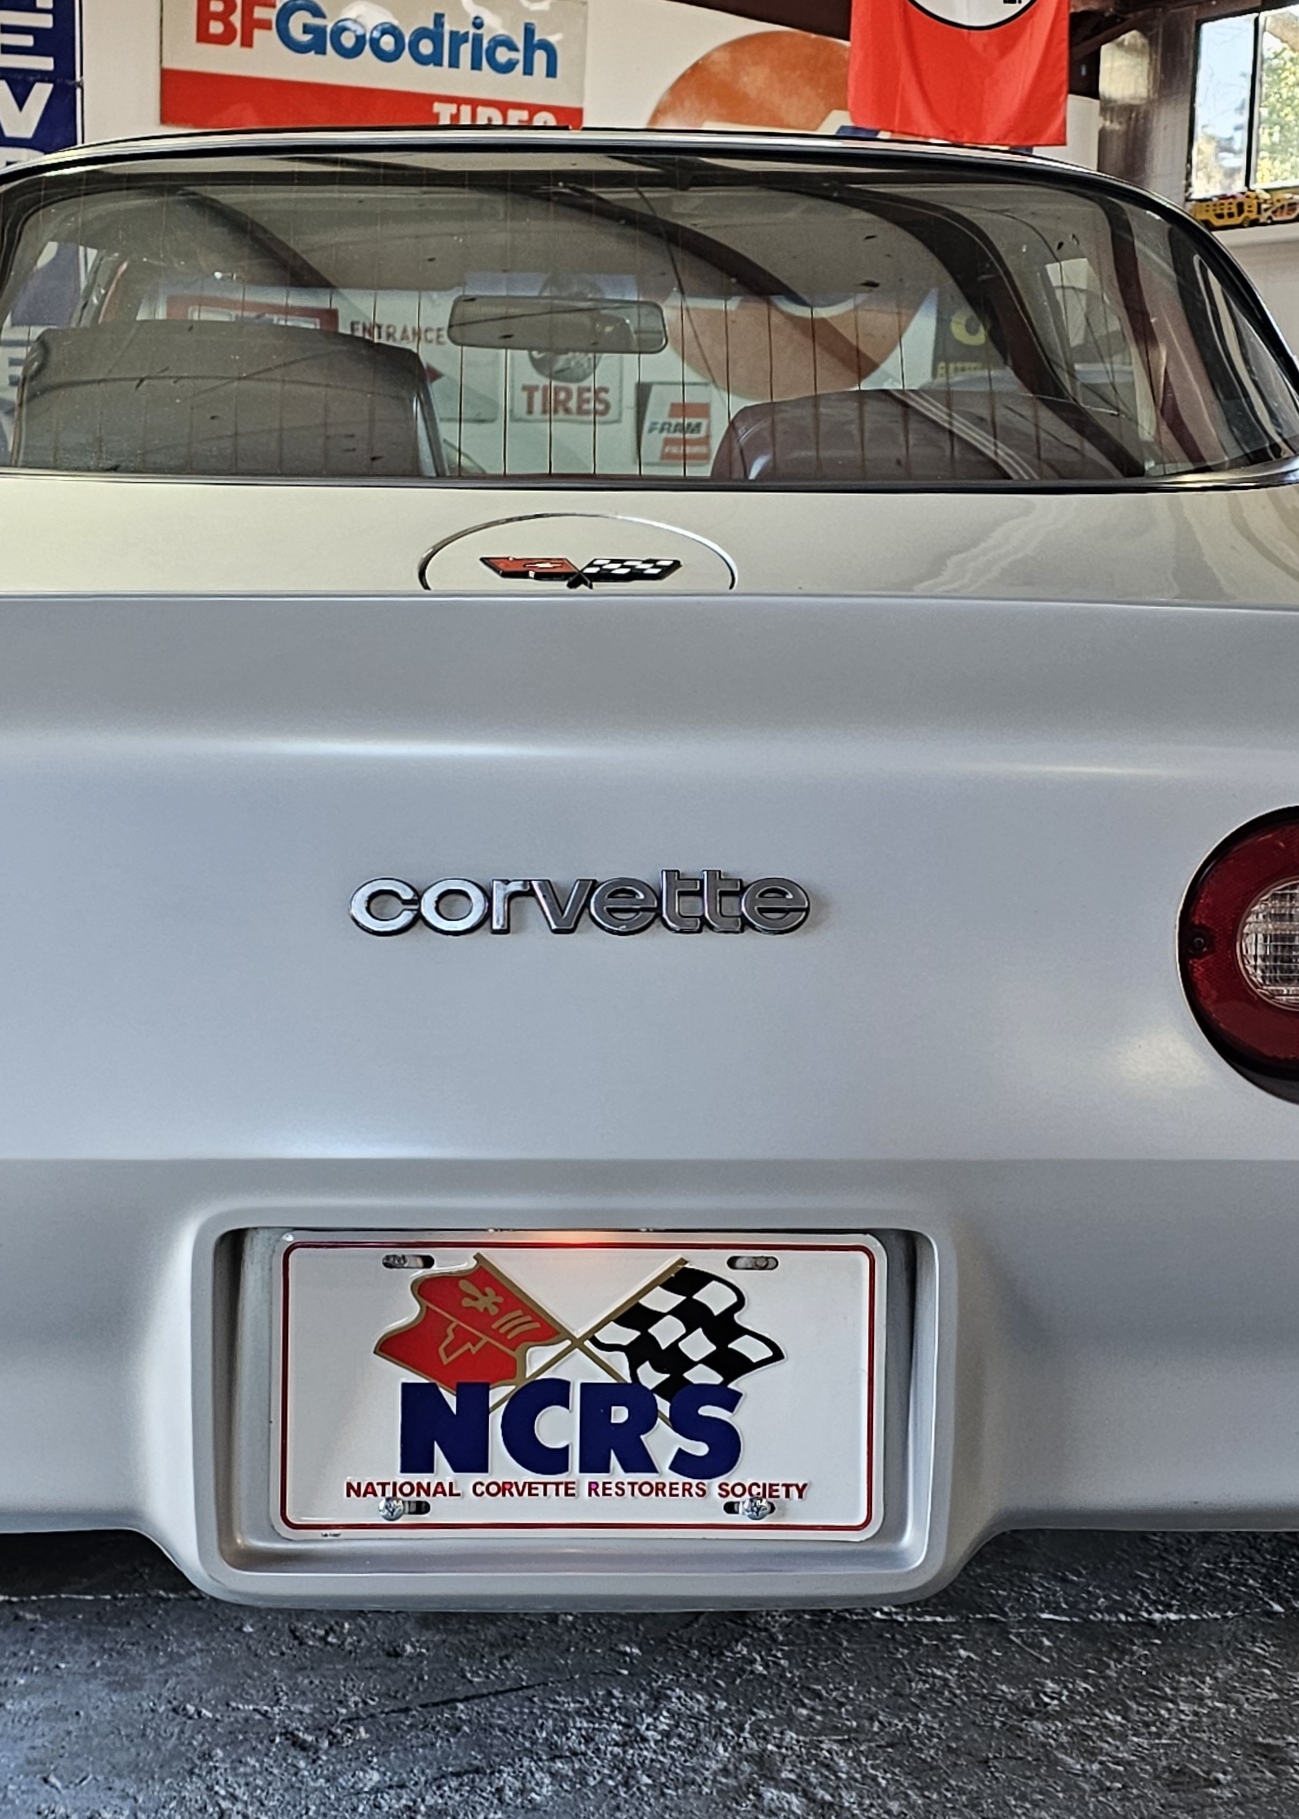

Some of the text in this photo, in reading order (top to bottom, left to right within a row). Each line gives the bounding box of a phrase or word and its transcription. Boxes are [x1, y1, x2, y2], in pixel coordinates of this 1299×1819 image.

[350, 320, 446, 346] ENTRANCE
[522, 384, 611, 417] TIRES
[648, 421, 702, 434] FRAM
[350, 868, 811, 935] corvette
[401, 1378, 744, 1480] NCRS
[344, 1481, 808, 1501] NATIONAL CORVETTE RESTORERS SOCIETY
